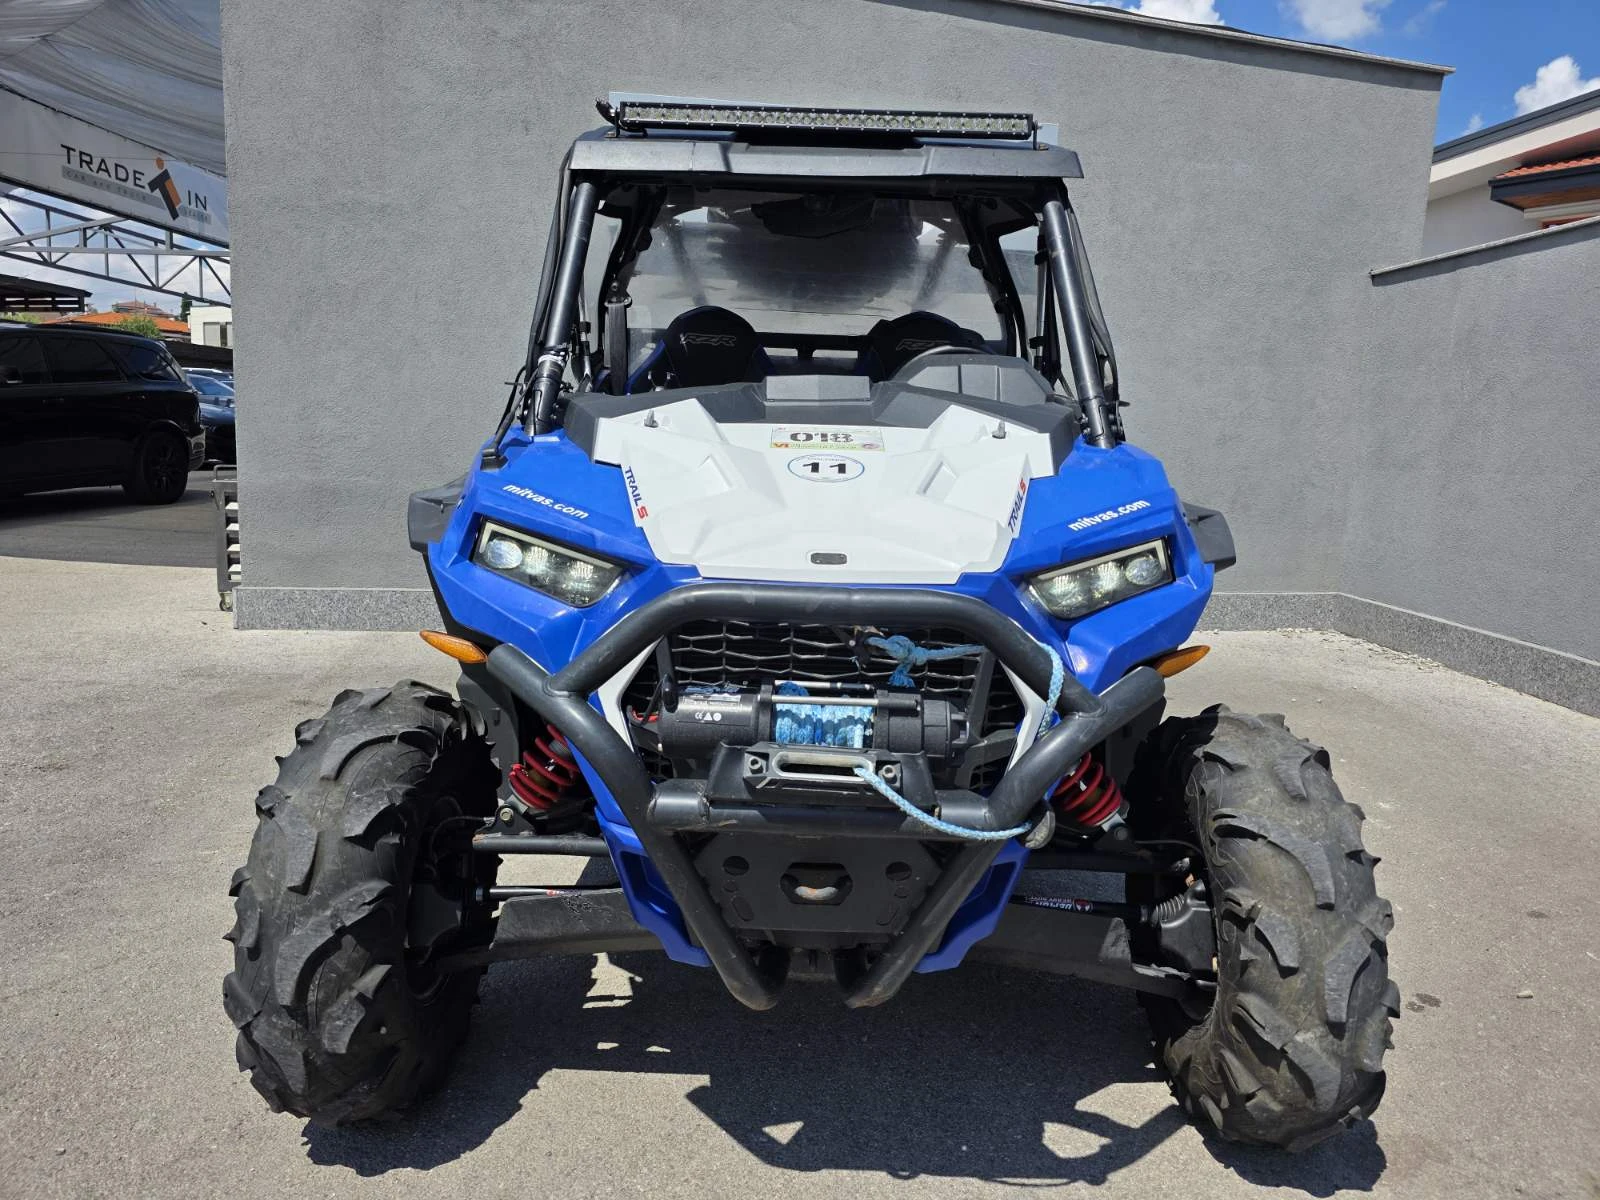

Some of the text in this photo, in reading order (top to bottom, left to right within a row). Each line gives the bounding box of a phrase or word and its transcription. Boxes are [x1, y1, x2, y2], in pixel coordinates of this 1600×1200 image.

[60, 144, 146, 190] TRADE
[187, 190, 208, 211] IN
[802, 462, 847, 474] 11
[502, 483, 589, 519] mitvas.com
[1067, 499, 1151, 531] mitvas.com
